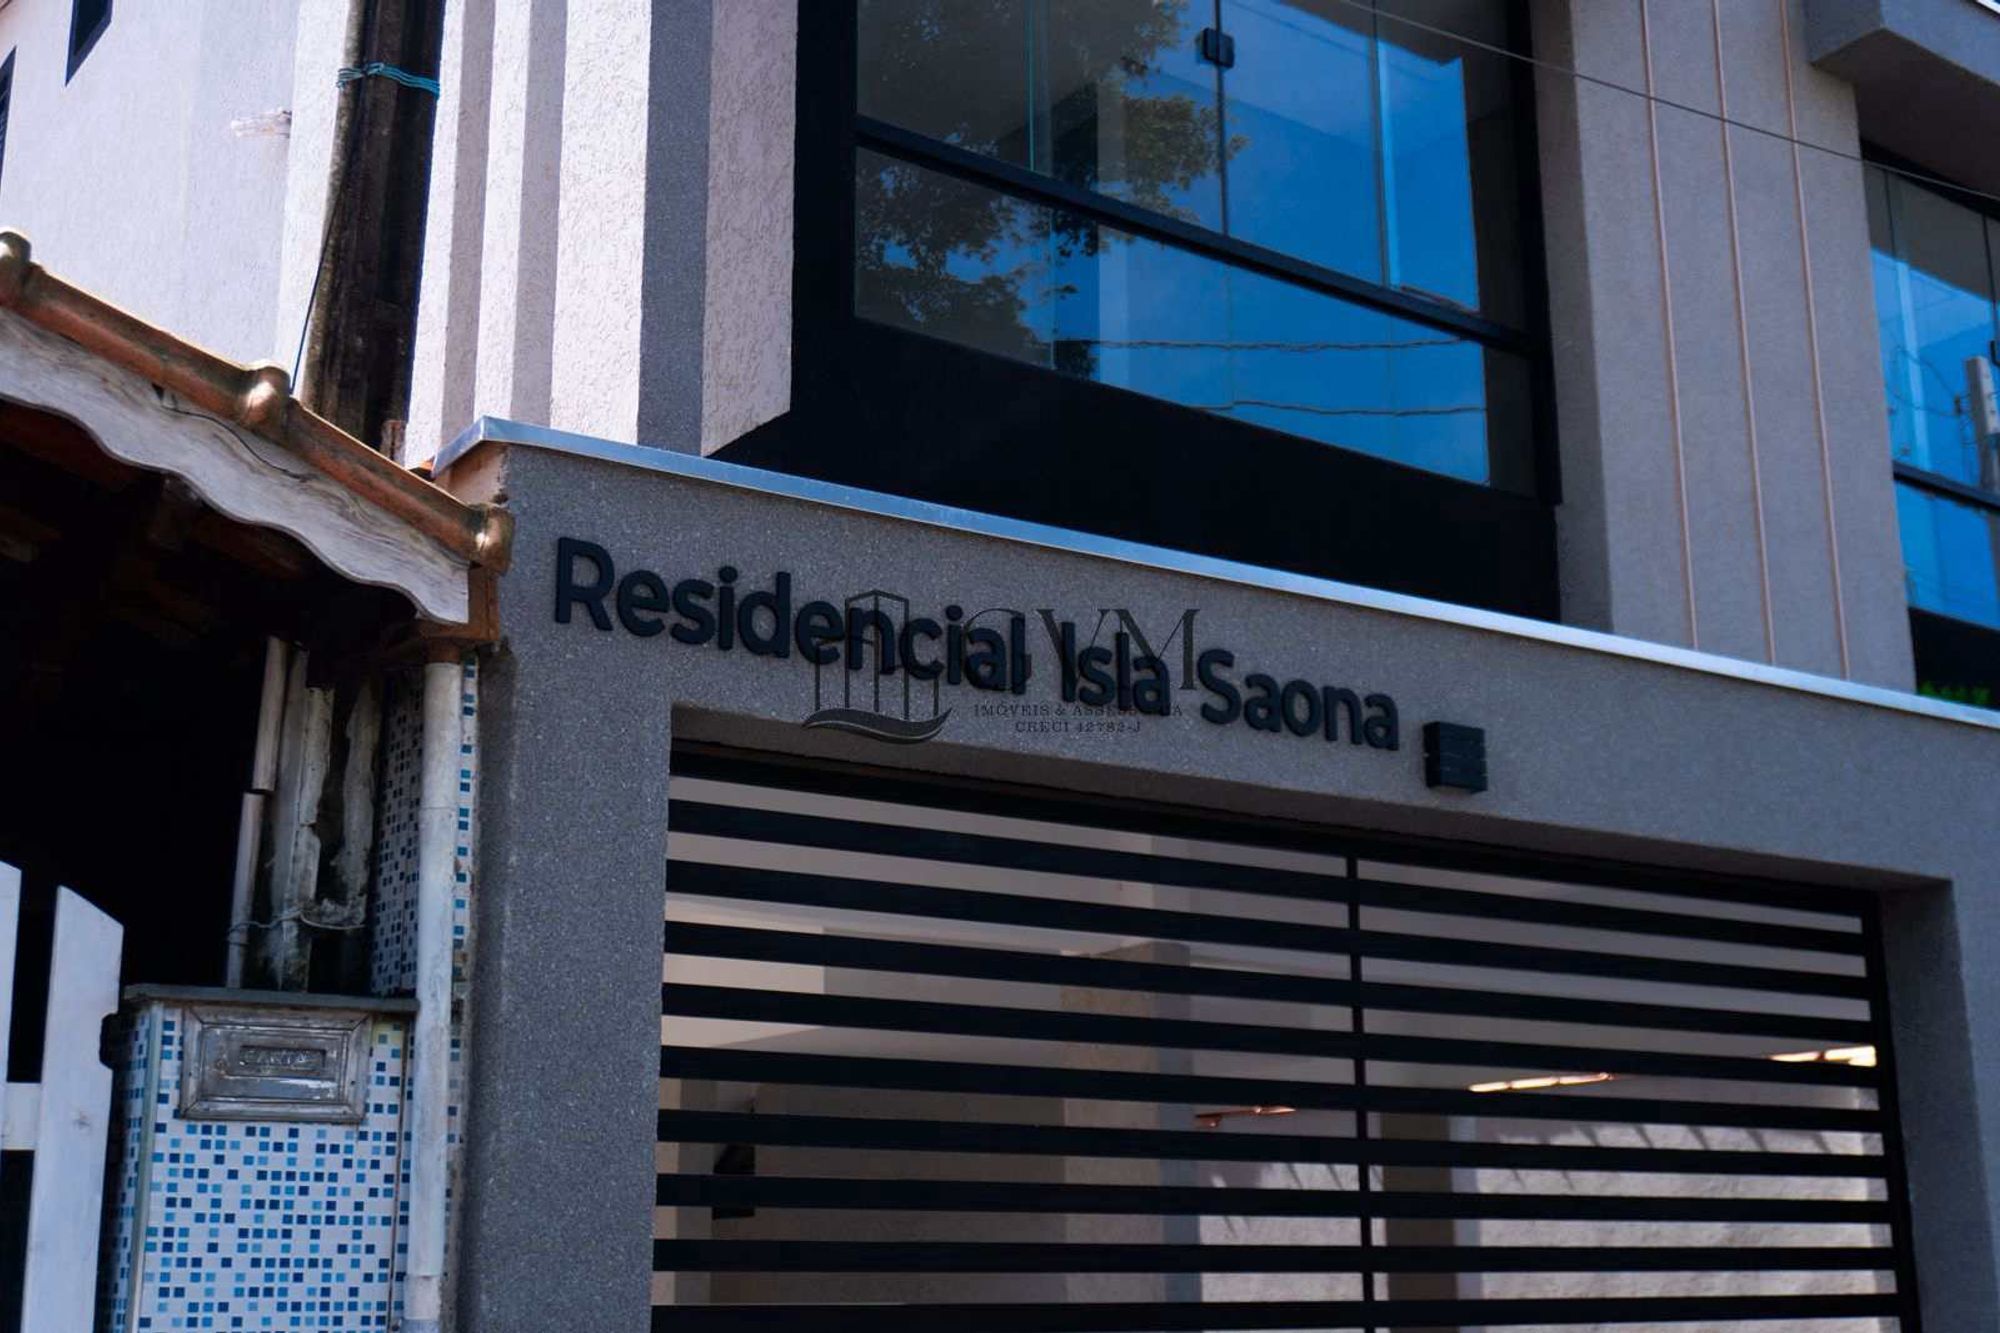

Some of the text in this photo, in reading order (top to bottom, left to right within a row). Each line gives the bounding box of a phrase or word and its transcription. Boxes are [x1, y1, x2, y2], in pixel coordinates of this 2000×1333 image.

[555, 536, 1400, 752] Residencial Isla Saona
